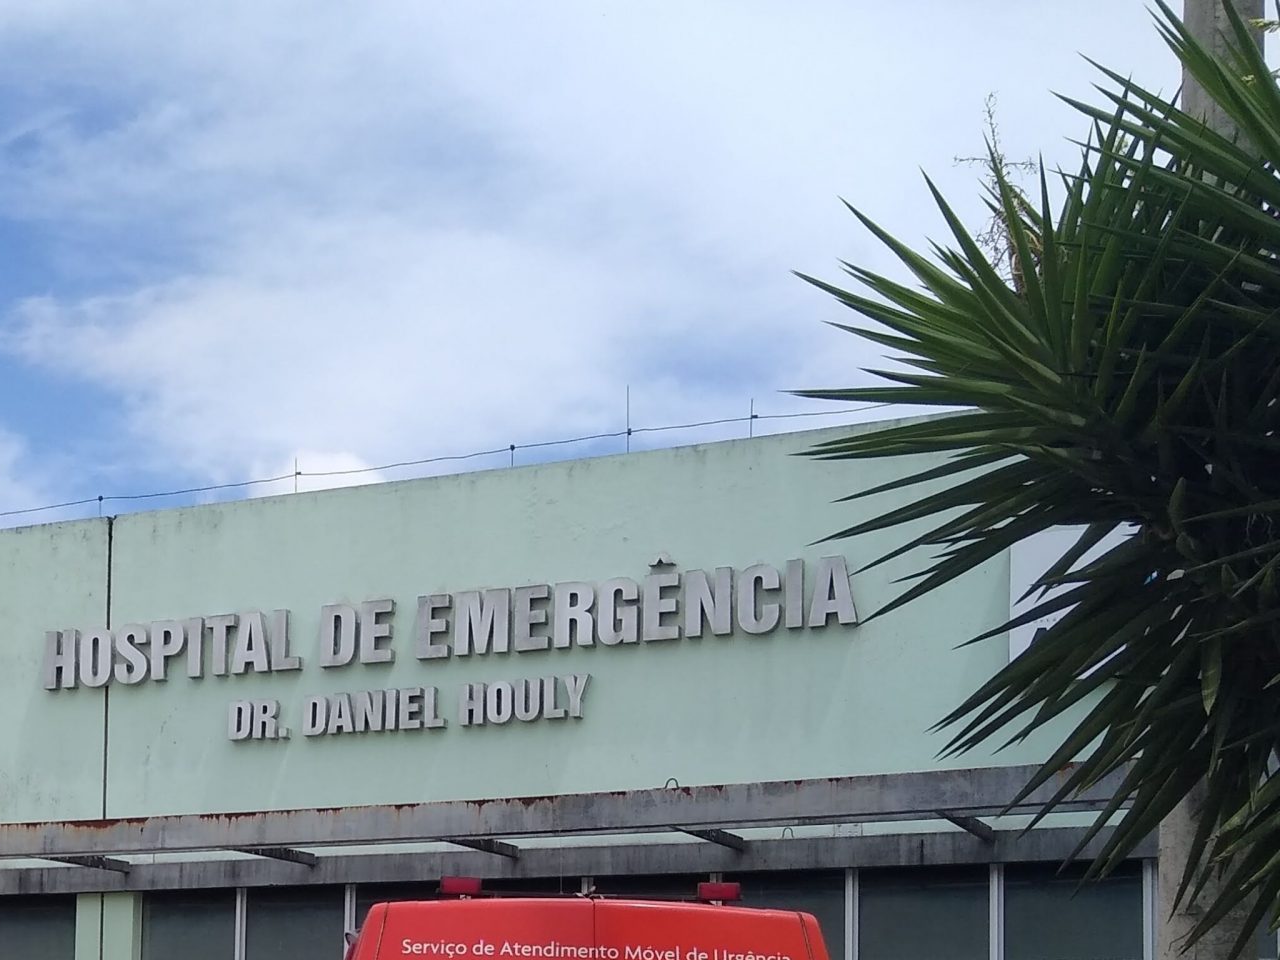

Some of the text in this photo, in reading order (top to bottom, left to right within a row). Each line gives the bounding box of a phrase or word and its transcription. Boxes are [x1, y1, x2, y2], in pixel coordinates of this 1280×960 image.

[43, 552, 859, 691] HOSPITAL DE EMERGÊNCIA
[227, 673, 592, 742] DR. DANIEL HOULY
[401, 938, 467, 959] Serviço
[472, 938, 495, 956] de
[499, 940, 619, 960] Atendimento
